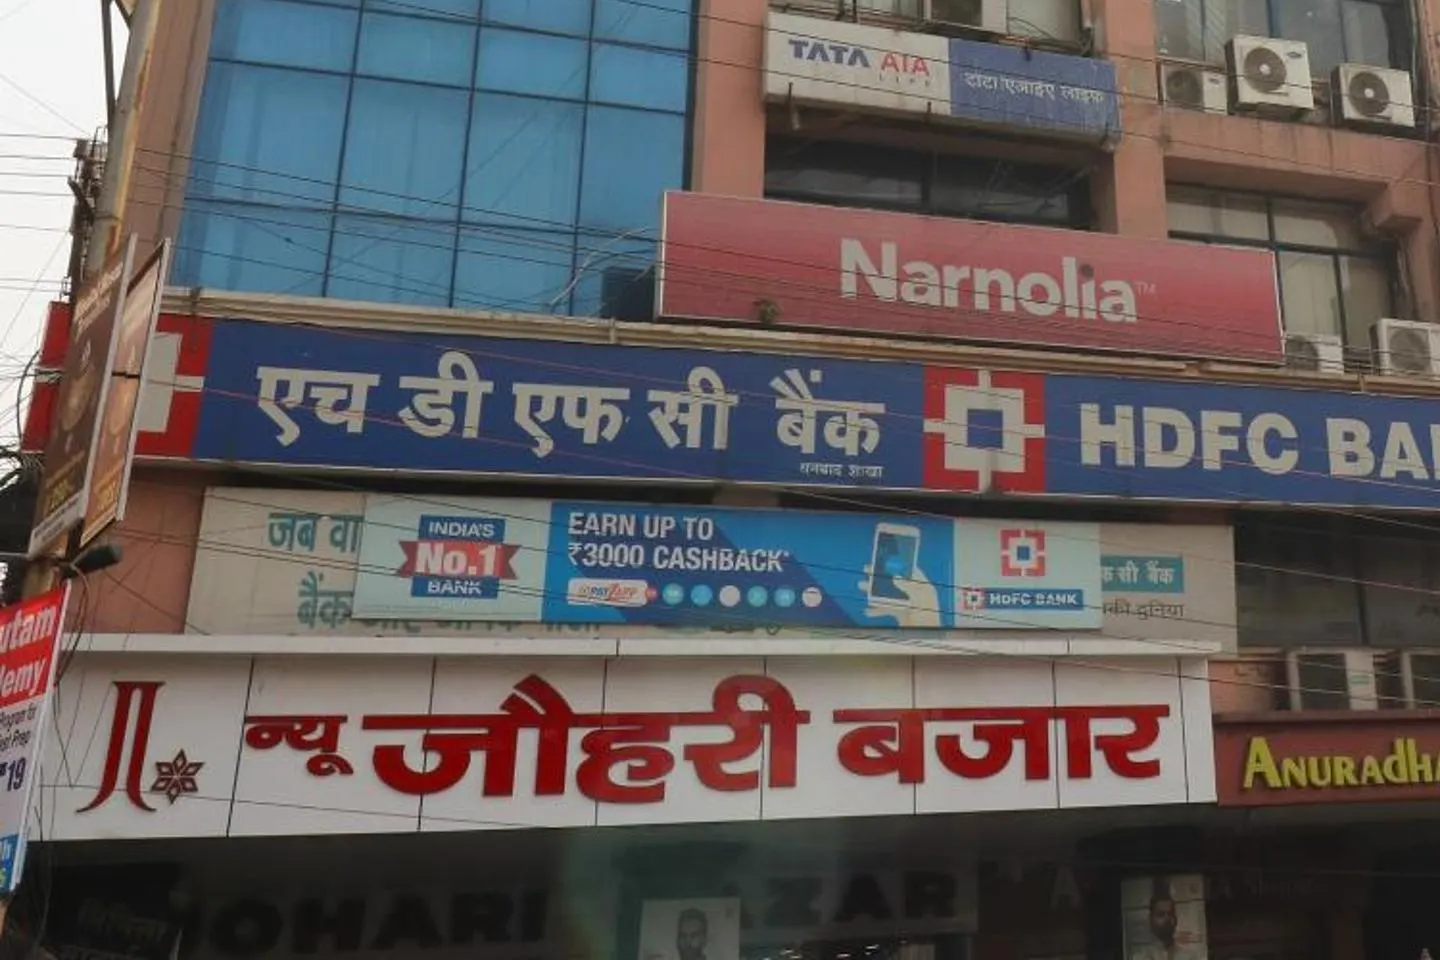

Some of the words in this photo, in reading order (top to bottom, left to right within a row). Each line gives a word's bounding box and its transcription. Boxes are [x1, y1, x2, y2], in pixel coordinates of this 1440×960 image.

[788, 39, 871, 68] TATA
[881, 52, 930, 77] AIA
[839, 237, 1137, 323] Narnolia
[257, 366, 380, 447] एच
[398, 350, 494, 439] डी
[512, 382, 630, 458] एफ
[647, 366, 739, 451] सी
[769, 368, 886, 457] बैंक
[1080, 402, 1299, 475] HDFC
[428, 521, 495, 538] INDIA'S
[568, 512, 635, 536] EARN
[643, 514, 677, 539] UP
[682, 516, 714, 541] TO
[415, 543, 499, 577] No.1
[567, 542, 644, 568] ₹3000
[427, 580, 483, 596] BANK
[989, 592, 1031, 607] HDFC
[1036, 593, 1078, 607] BANK
[0, 605, 57, 654] utam
[0, 657, 47, 698] emy
[244, 715, 355, 777] न्यू
[362, 673, 811, 805] जौहरी
[833, 704, 1171, 785] बजार
[208, 889, 550, 954] OHARI
